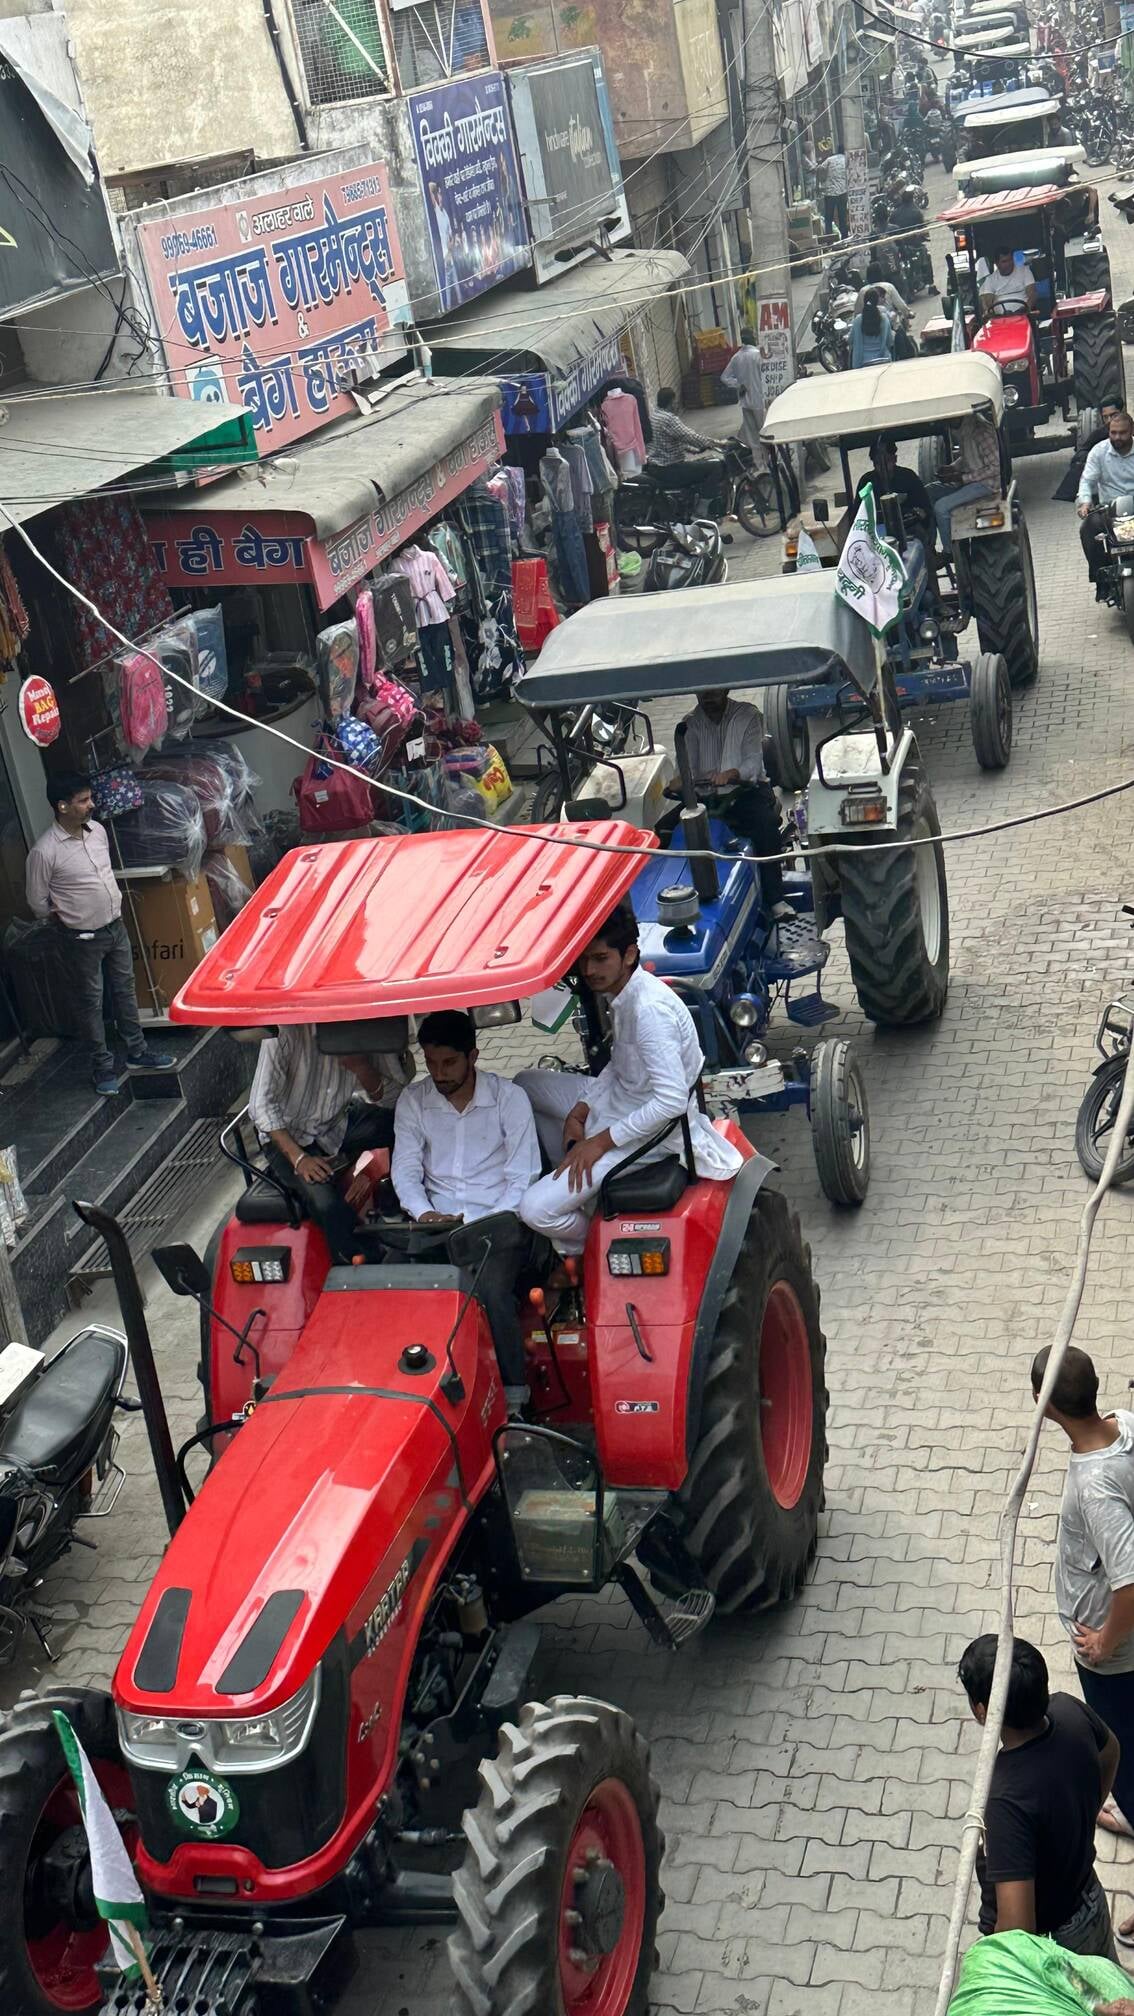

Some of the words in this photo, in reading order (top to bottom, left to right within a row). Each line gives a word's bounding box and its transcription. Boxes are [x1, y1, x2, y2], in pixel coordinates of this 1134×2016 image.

[252, 205, 292, 235] अलाहर
[293, 194, 314, 222] वाले
[168, 244, 279, 352] बजाज
[297, 311, 313, 339] &
[238, 342, 300, 432] बैग
[765, 374, 784, 385] SHIP
[327, 516, 376, 578] बजाज
[436, 461, 446, 488] &
[176, 525, 225, 576] ही
[232, 523, 305, 571] बैग
[33, 696, 55, 715] BAG
[133, 939, 184, 960] sfari
[364, 1558, 410, 1646] KARTAR
